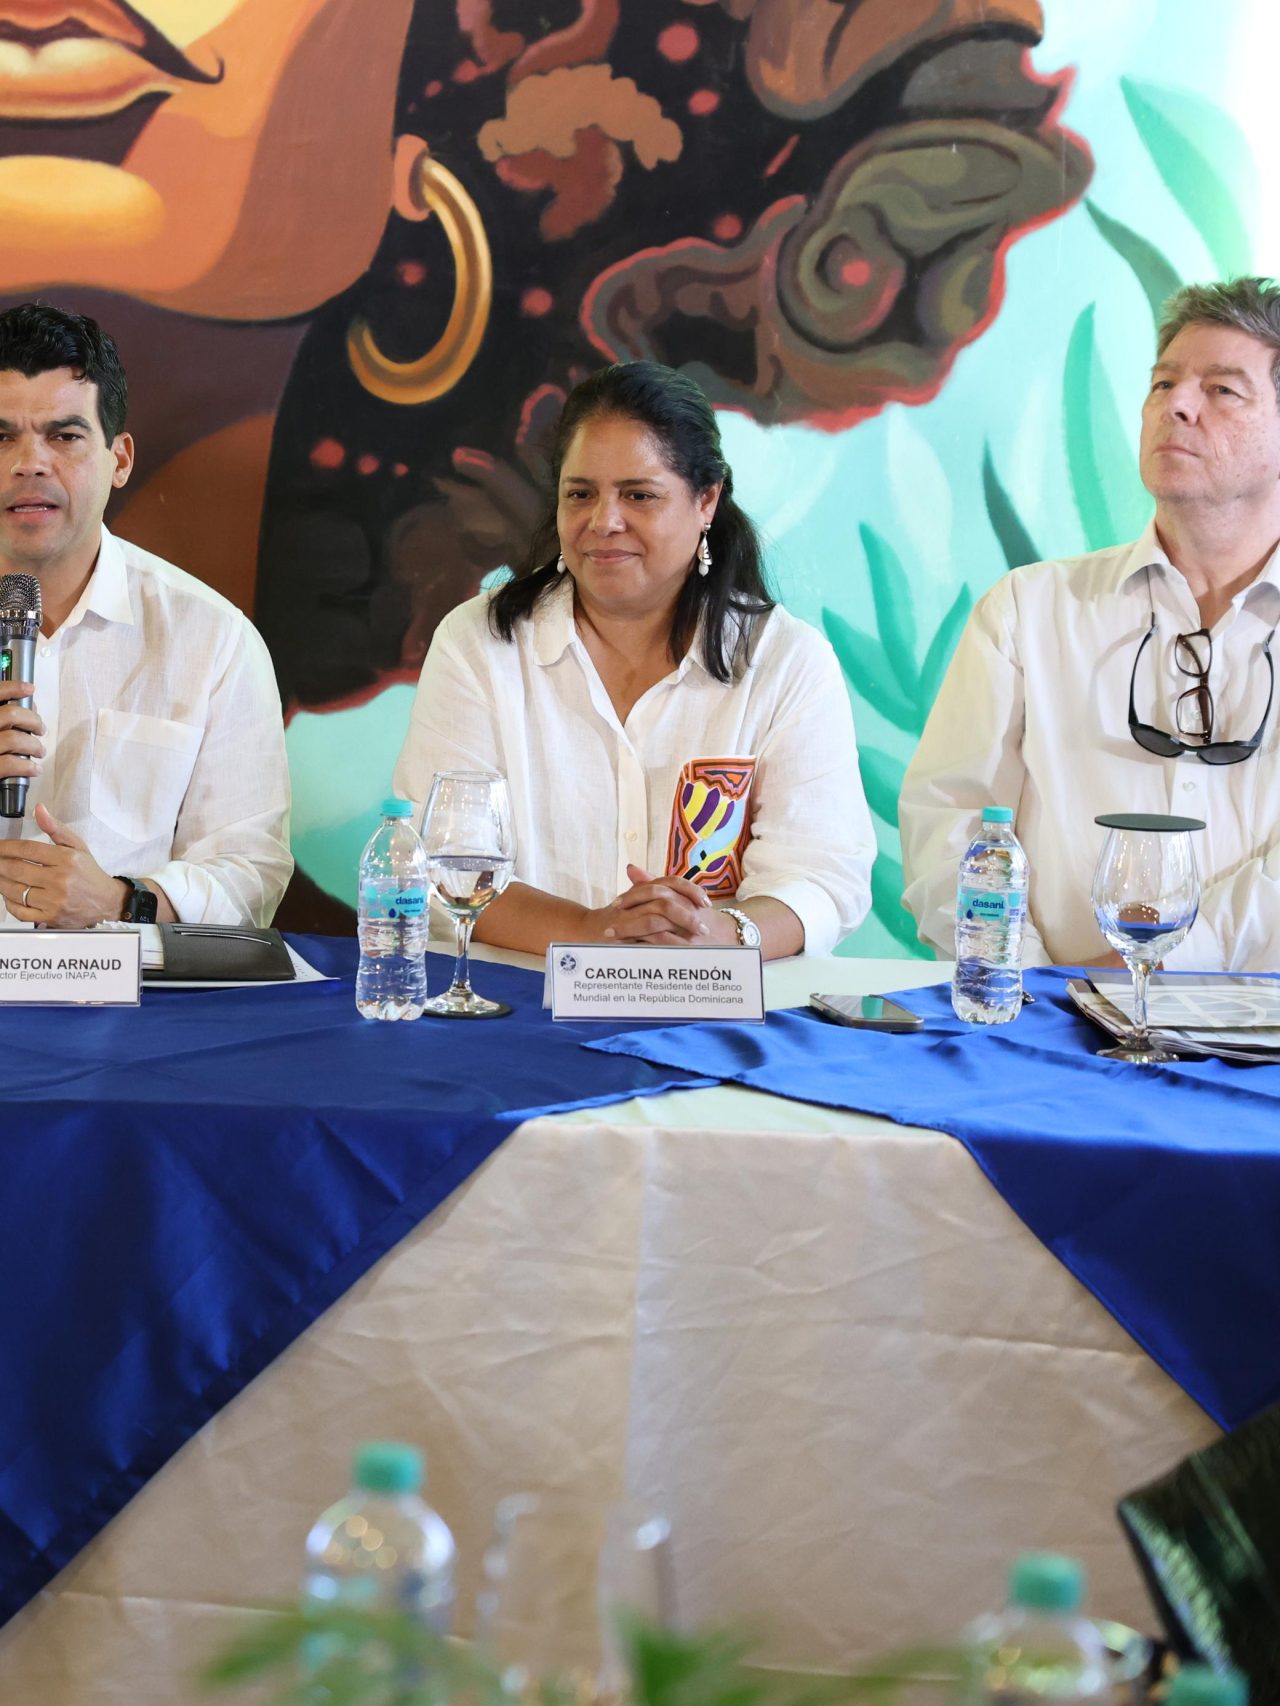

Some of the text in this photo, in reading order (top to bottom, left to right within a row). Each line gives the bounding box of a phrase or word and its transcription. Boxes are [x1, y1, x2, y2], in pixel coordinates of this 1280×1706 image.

[972, 899, 1004, 909] dasani
[57, 959, 122, 971] ARNAUD
[20, 971, 63, 981] Ejecutivo
[65, 971, 97, 980] INAPA
[585, 967, 663, 980] CAROLINA
[668, 966, 732, 981] RENDÓN
[573, 981, 742, 992] Representante Residente del Banco
[573, 993, 611, 1002] Mundial
[627, 993, 637, 1003] la
[639, 993, 686, 1004] República
[688, 994, 744, 1004] Dominicana
